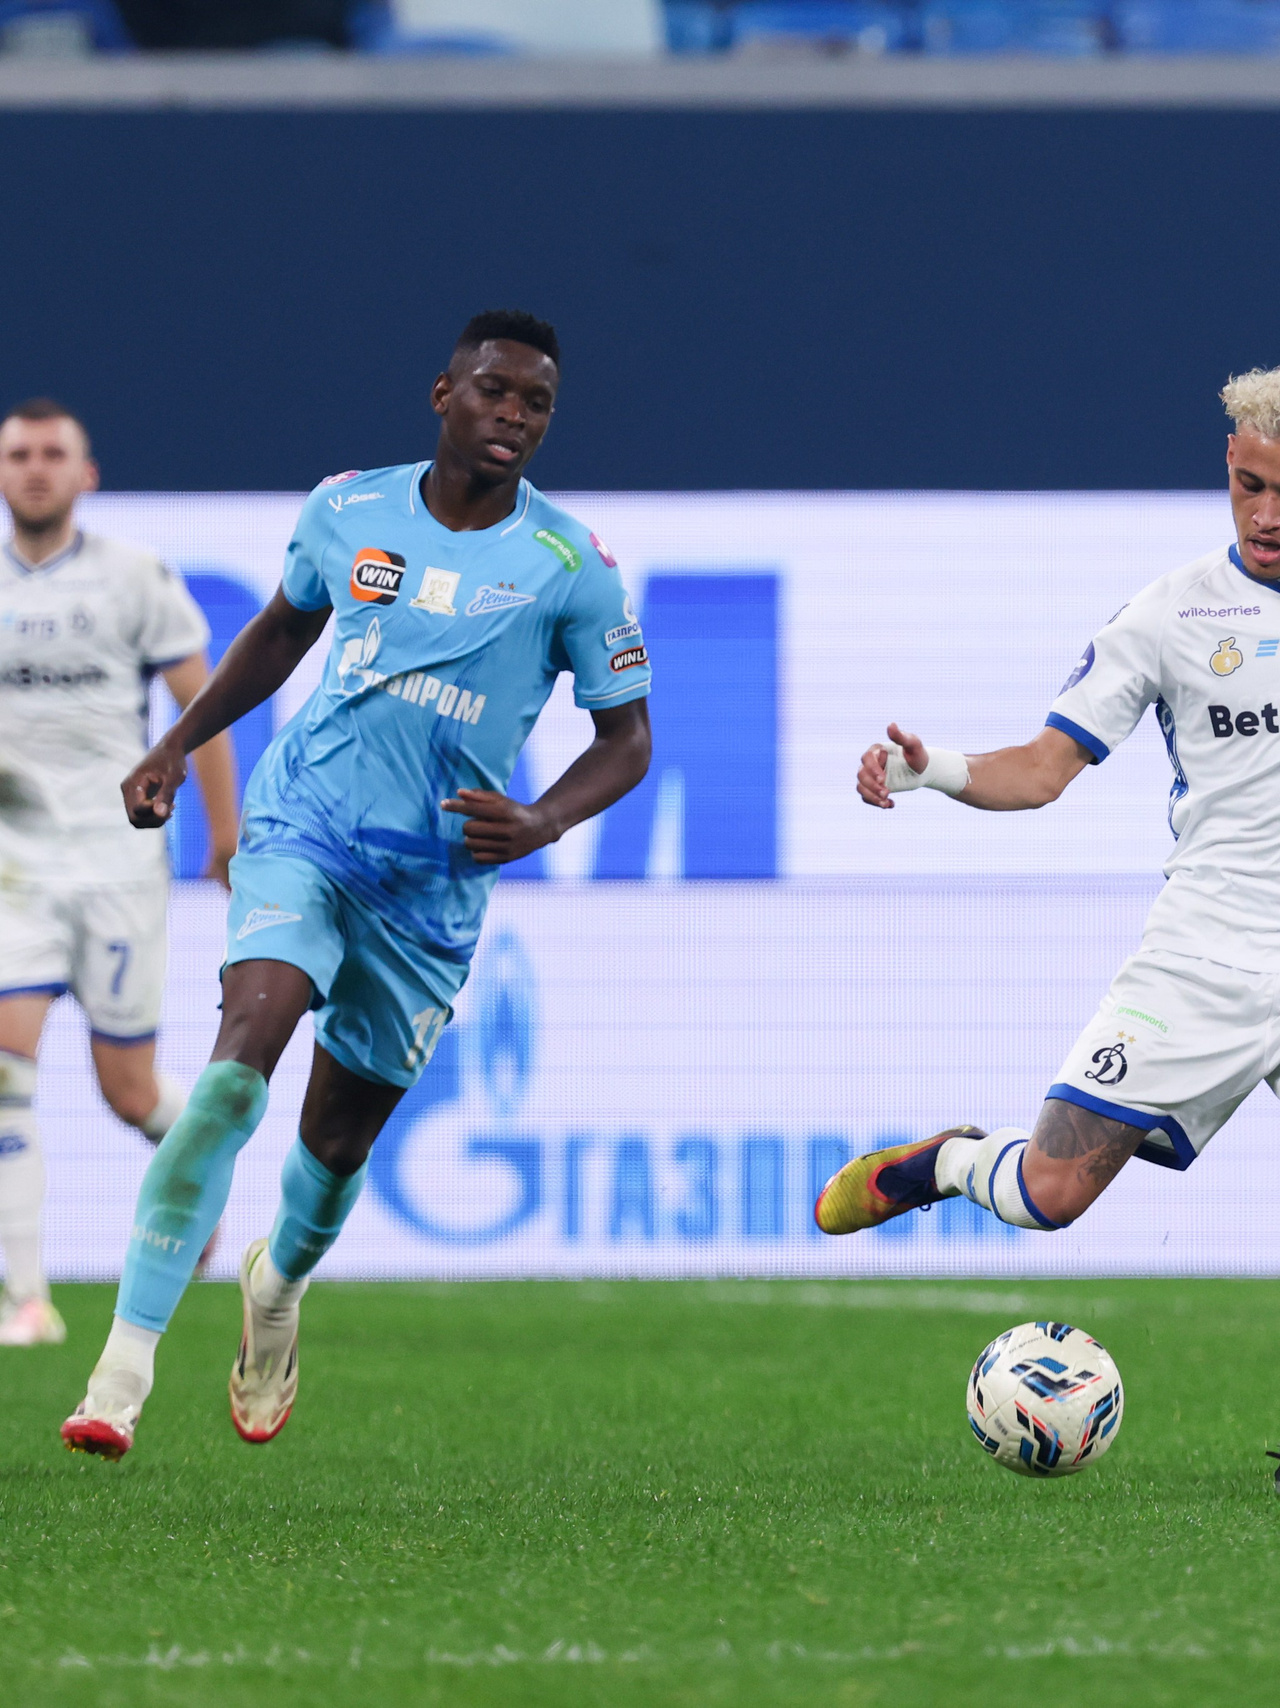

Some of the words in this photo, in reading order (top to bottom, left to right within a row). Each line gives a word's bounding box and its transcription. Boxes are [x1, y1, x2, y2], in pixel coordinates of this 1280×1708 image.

[360, 565, 400, 588] WIN
[1178, 605, 1261, 618] wildberries
[107, 940, 131, 997] 7
[1116, 1006, 1168, 1033] greenworks
